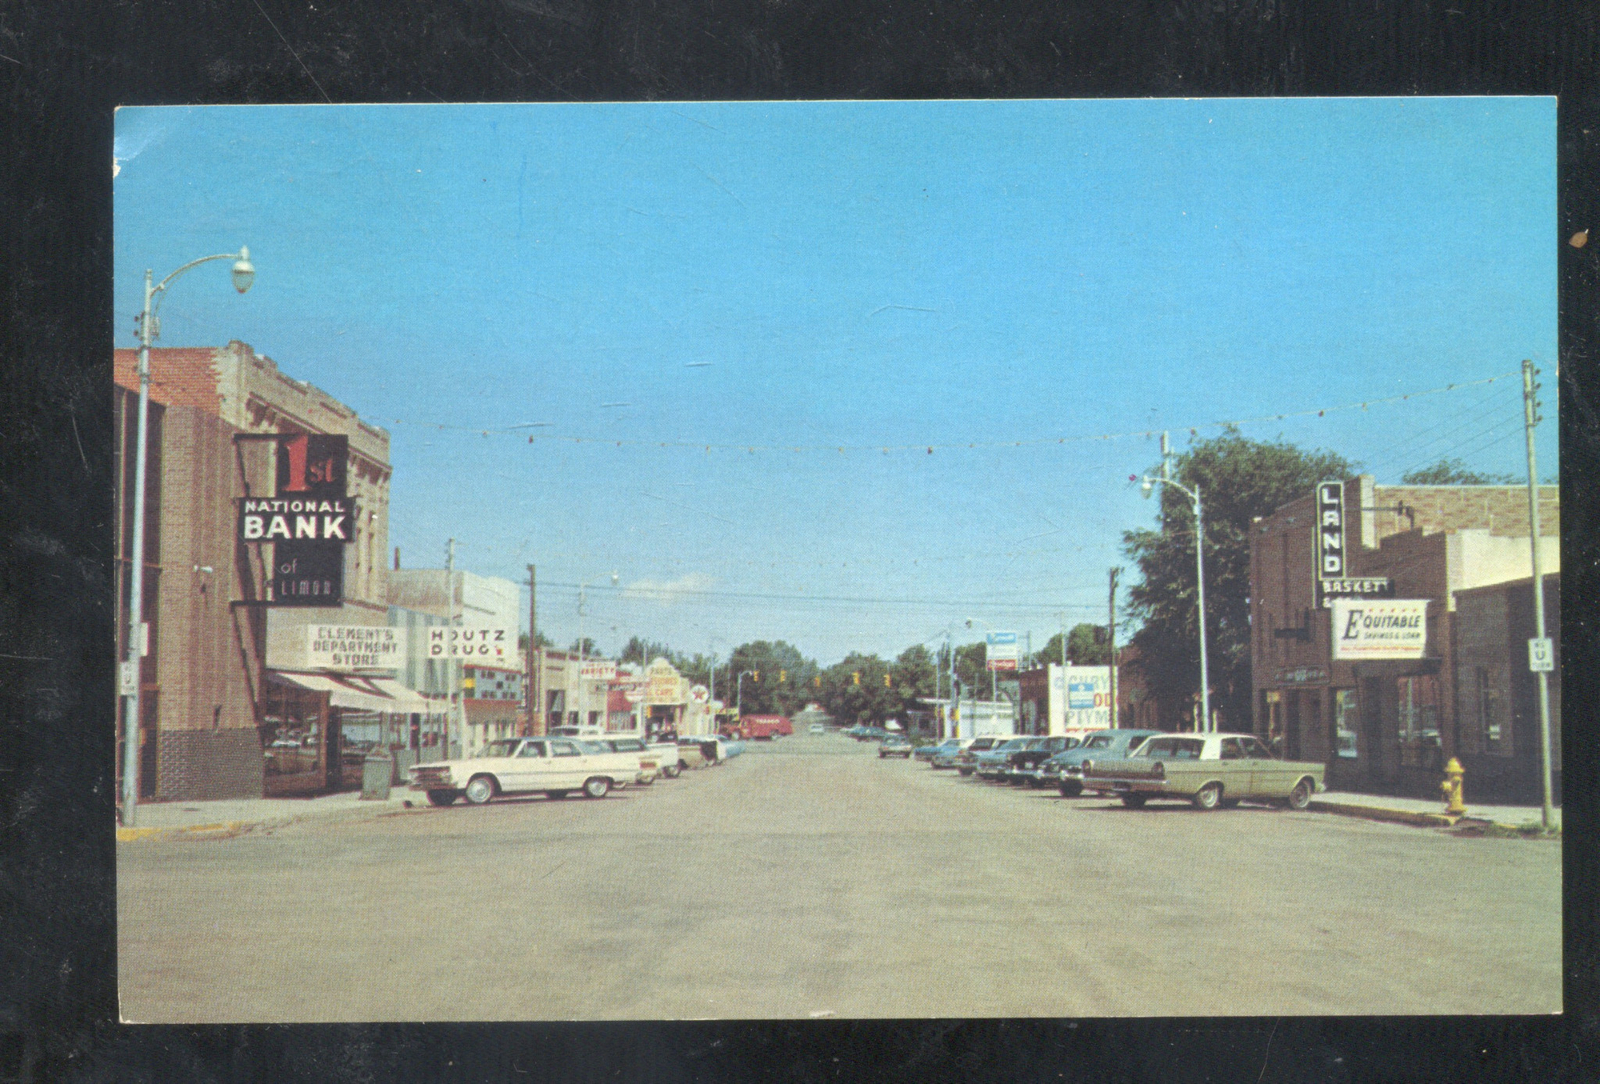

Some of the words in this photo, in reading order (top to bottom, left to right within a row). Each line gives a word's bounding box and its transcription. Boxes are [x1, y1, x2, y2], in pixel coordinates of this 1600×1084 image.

[282, 434, 335, 492] 1st
[245, 501, 345, 513] NATIONAL
[244, 515, 346, 539] BANK
[1321, 488, 1341, 572] LAND
[280, 558, 297, 574] of
[1341, 609, 1421, 640] EQUITABLE
[317, 626, 394, 640] CLEMENT'S
[312, 640, 398, 654] DEPARTMENT
[332, 653, 379, 666] STORE
[1535, 650, 1545, 660] U
